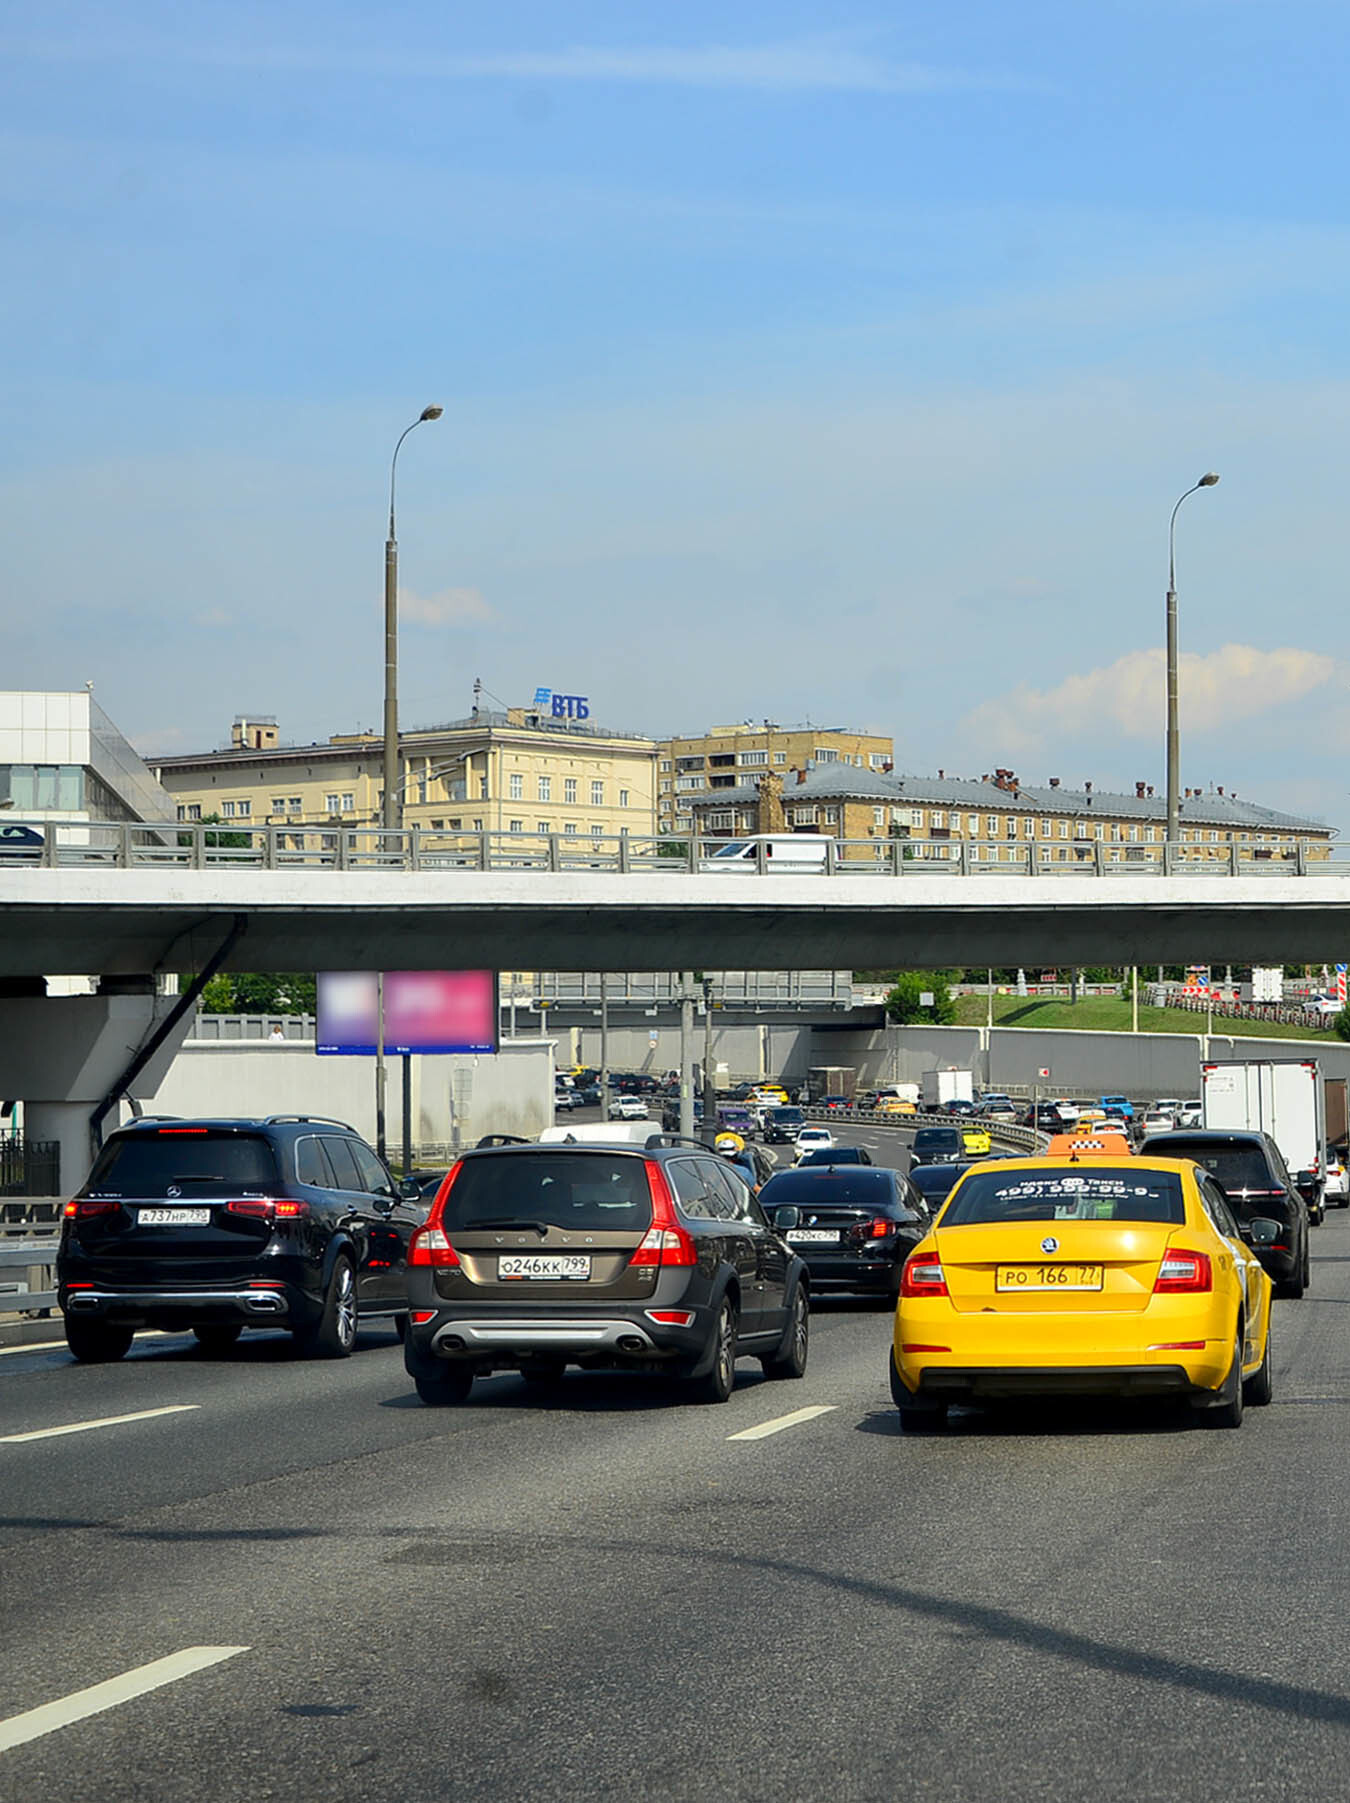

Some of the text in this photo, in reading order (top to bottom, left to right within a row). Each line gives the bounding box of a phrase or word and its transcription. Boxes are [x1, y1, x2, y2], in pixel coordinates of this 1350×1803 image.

[552, 694, 590, 719] ВТБ
[495, 1235, 593, 1244] VOLVO
[503, 1257, 587, 1274] О246КК 799
[1006, 1265, 1097, 1284] РО 166 77
